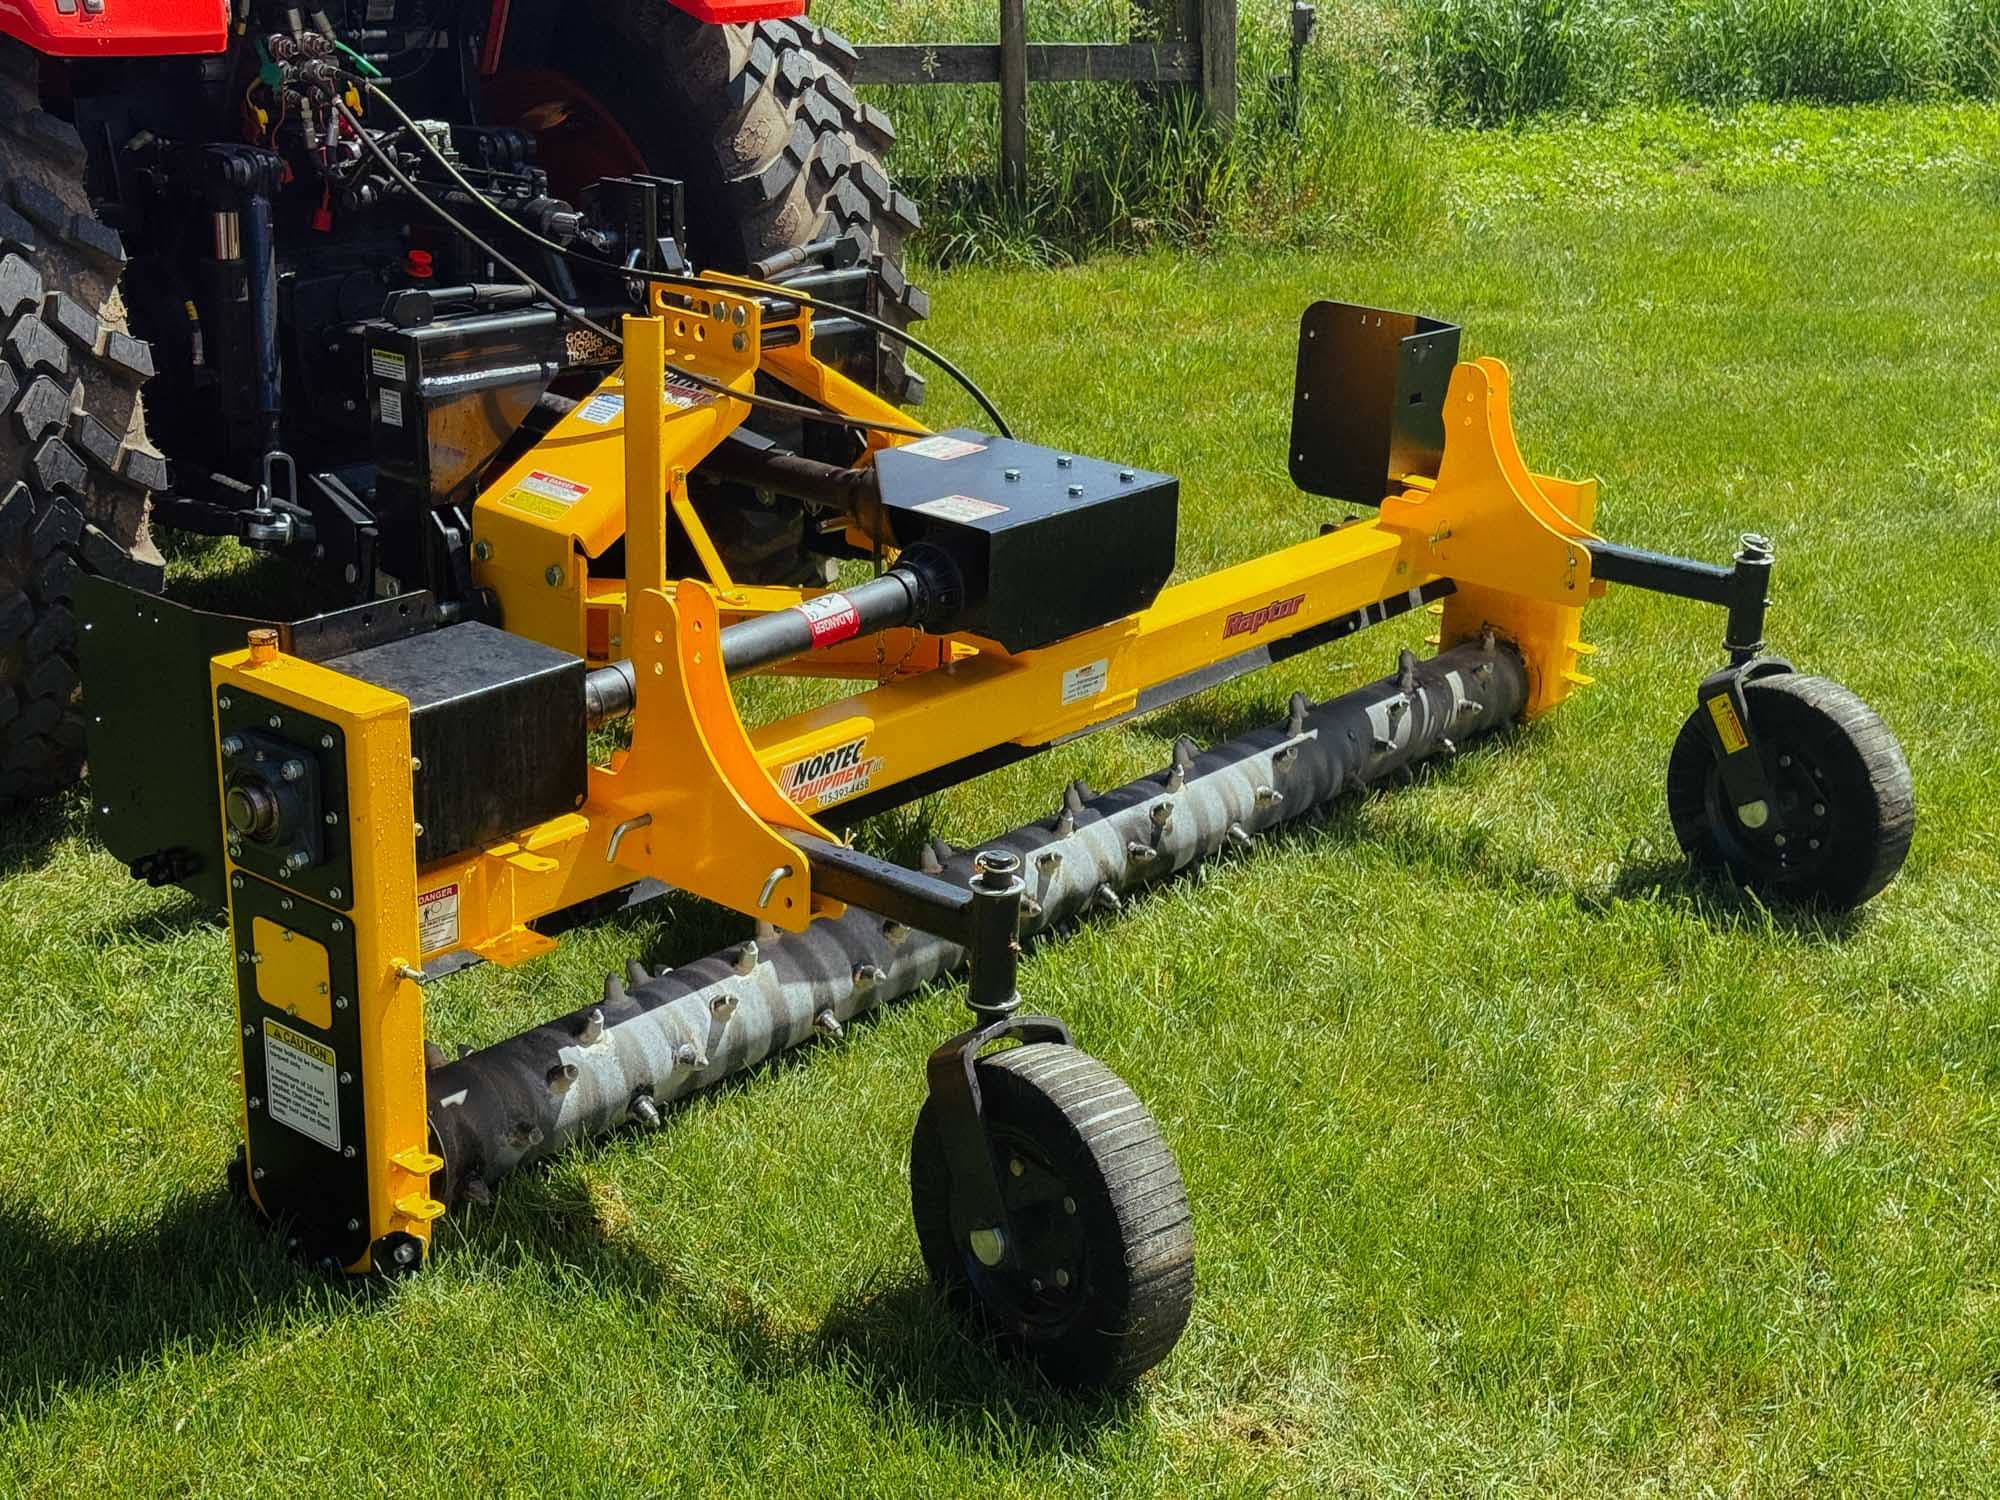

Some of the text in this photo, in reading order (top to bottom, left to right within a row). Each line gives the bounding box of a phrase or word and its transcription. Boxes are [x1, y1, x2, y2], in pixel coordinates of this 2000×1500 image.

[566, 338, 602, 352] WORKS
[567, 345, 617, 361] TRACTORS
[1222, 593, 1306, 640] Raptor
[793, 739, 866, 787] NORTEC
[790, 758, 873, 801] EQUIPMENT
[418, 887, 453, 904] DANGER
[284, 1031, 326, 1060] CAUTION
